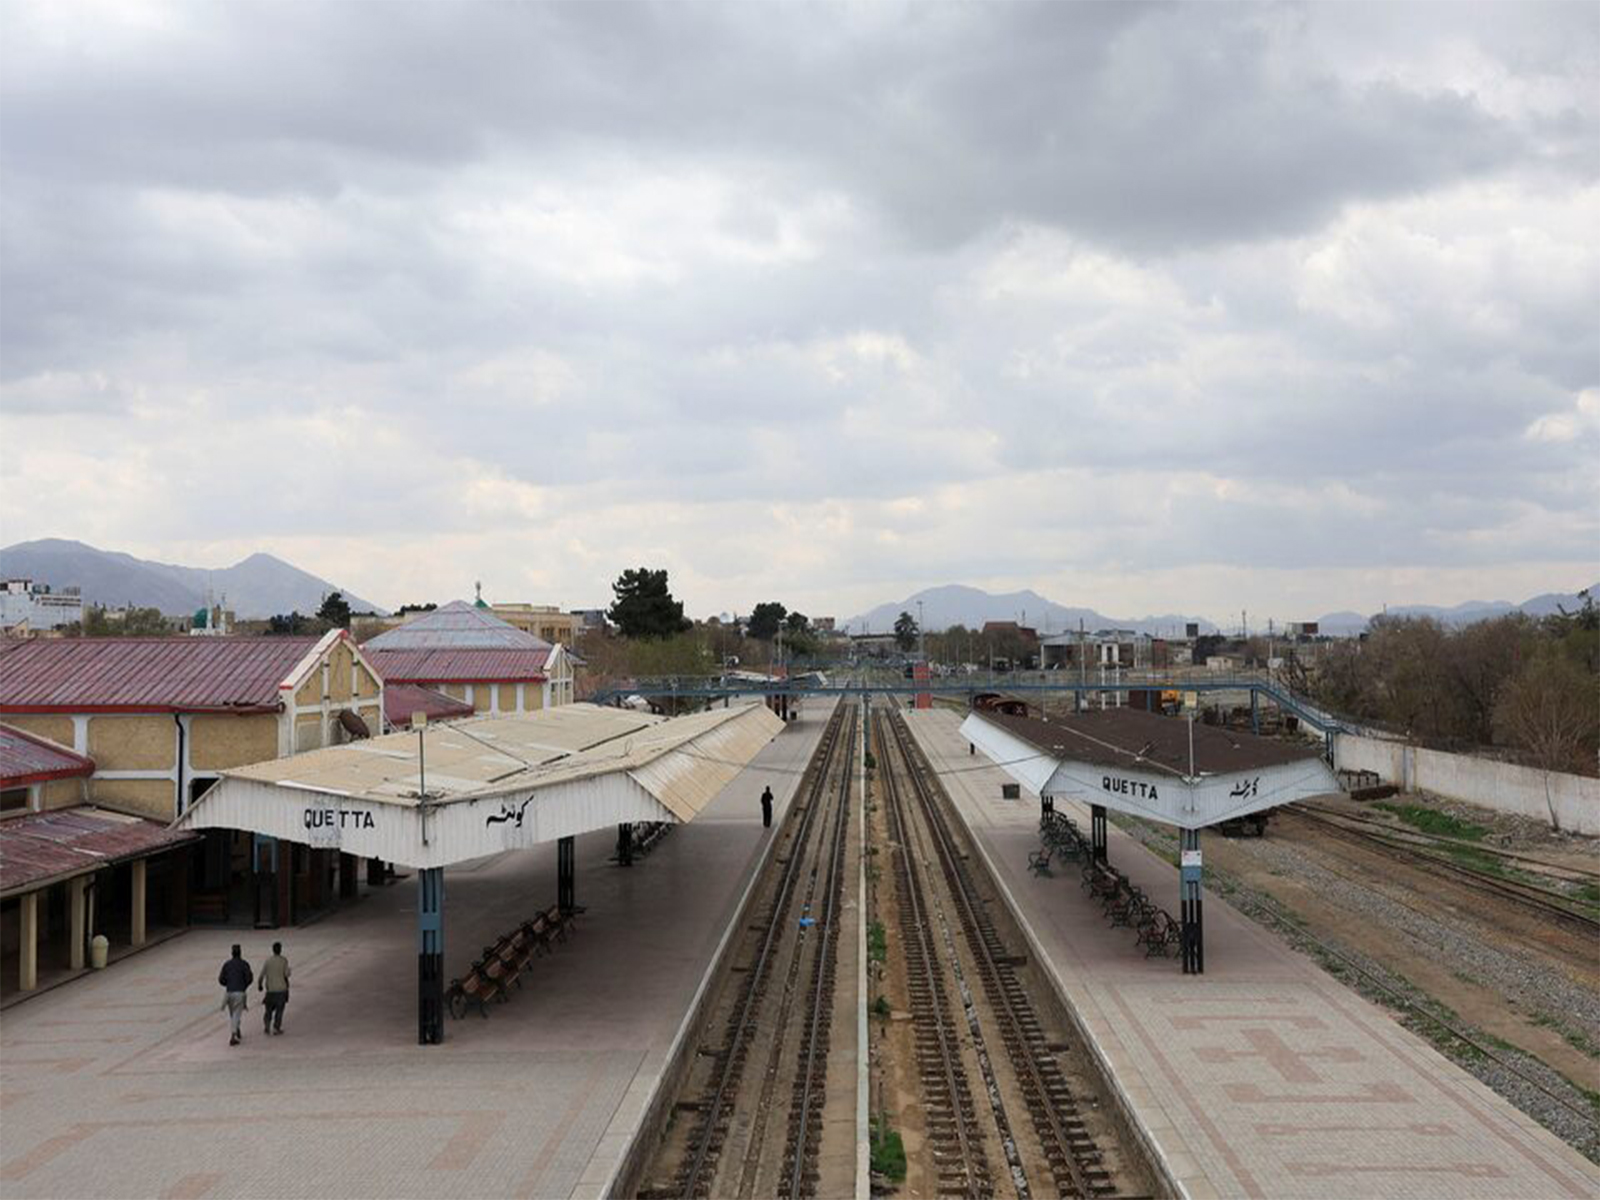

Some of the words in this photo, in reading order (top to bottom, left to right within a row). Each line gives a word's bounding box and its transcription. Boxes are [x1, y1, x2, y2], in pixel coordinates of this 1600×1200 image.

[1103, 777, 1158, 800] QUETTA
[304, 809, 375, 829] QUETTA
[487, 796, 534, 829] کوئٹہ
